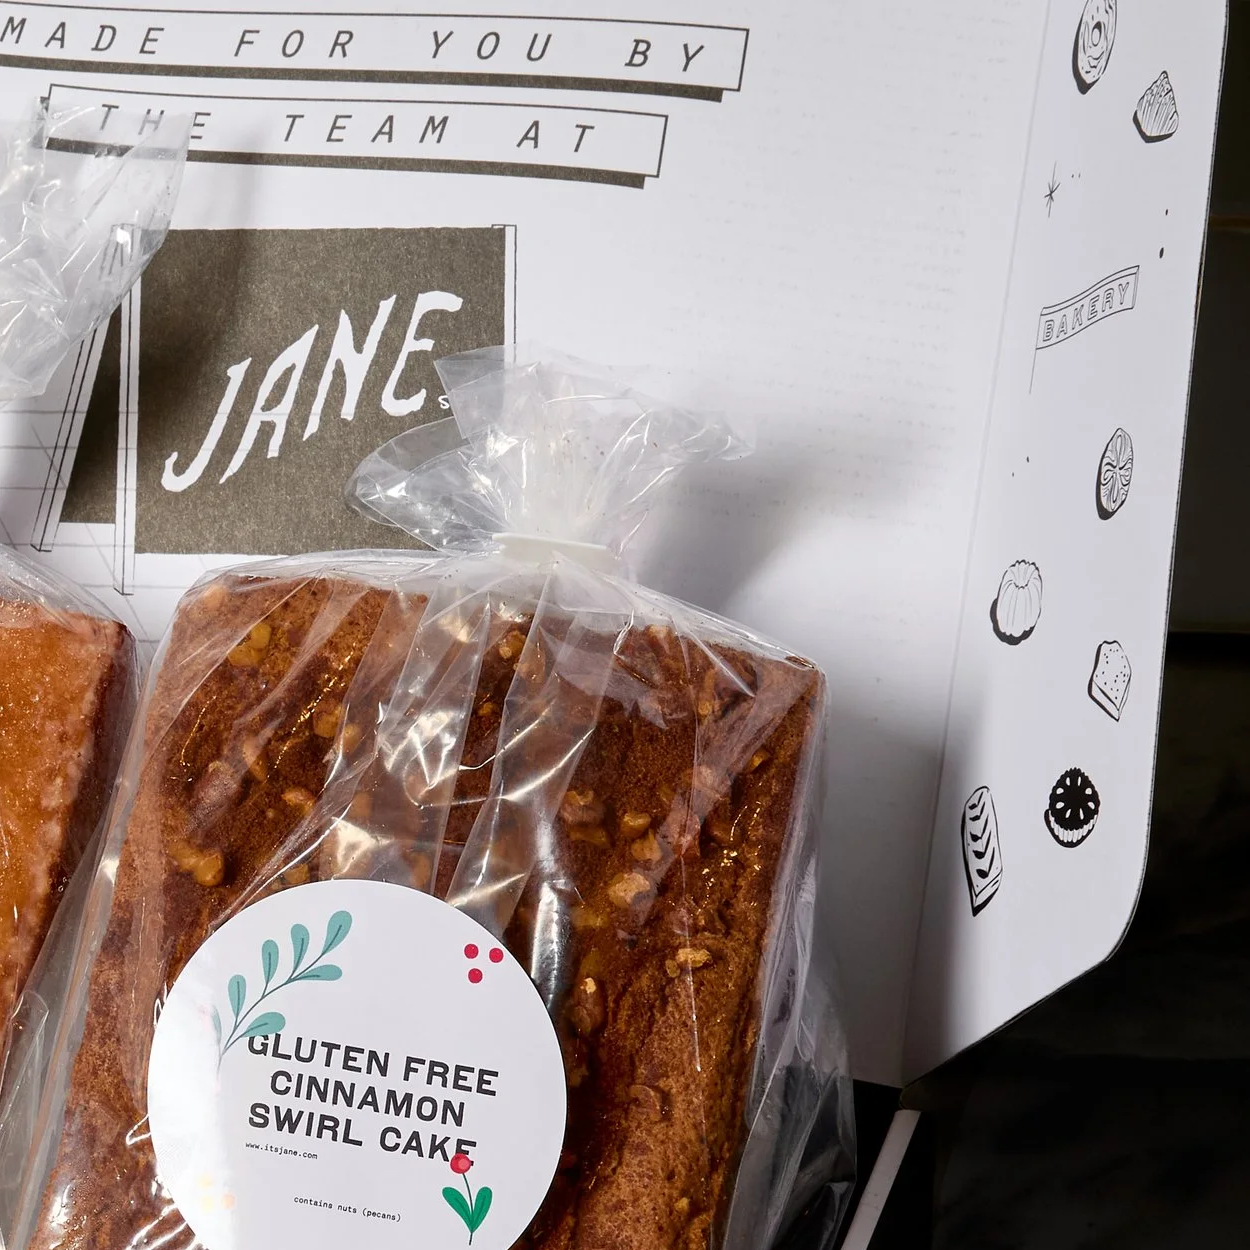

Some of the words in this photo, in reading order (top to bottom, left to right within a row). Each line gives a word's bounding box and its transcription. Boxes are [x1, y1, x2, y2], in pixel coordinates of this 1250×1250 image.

[0, 16, 165, 55] MADE
[233, 29, 355, 59] FOR
[430, 31, 553, 62] YOU
[624, 39, 705, 73] BY
[99, 103, 212, 140] THE
[283, 114, 450, 144] TEAM
[515, 120, 595, 153] AT
[1043, 281, 1131, 342] BAKERY
[161, 289, 464, 492] JANE
[246, 1032, 391, 1078] GLUTEN
[402, 1055, 500, 1097] FREE
[269, 1069, 465, 1128] CINNAMON
[244, 1141, 319, 1160] www.itsjane.com
[247, 1102, 364, 1147] SWIRL
[378, 1125, 479, 1167] CAKE
[293, 1195, 334, 1210] contains
[337, 1203, 357, 1215] nuts
[361, 1206, 402, 1224] (pecans)
